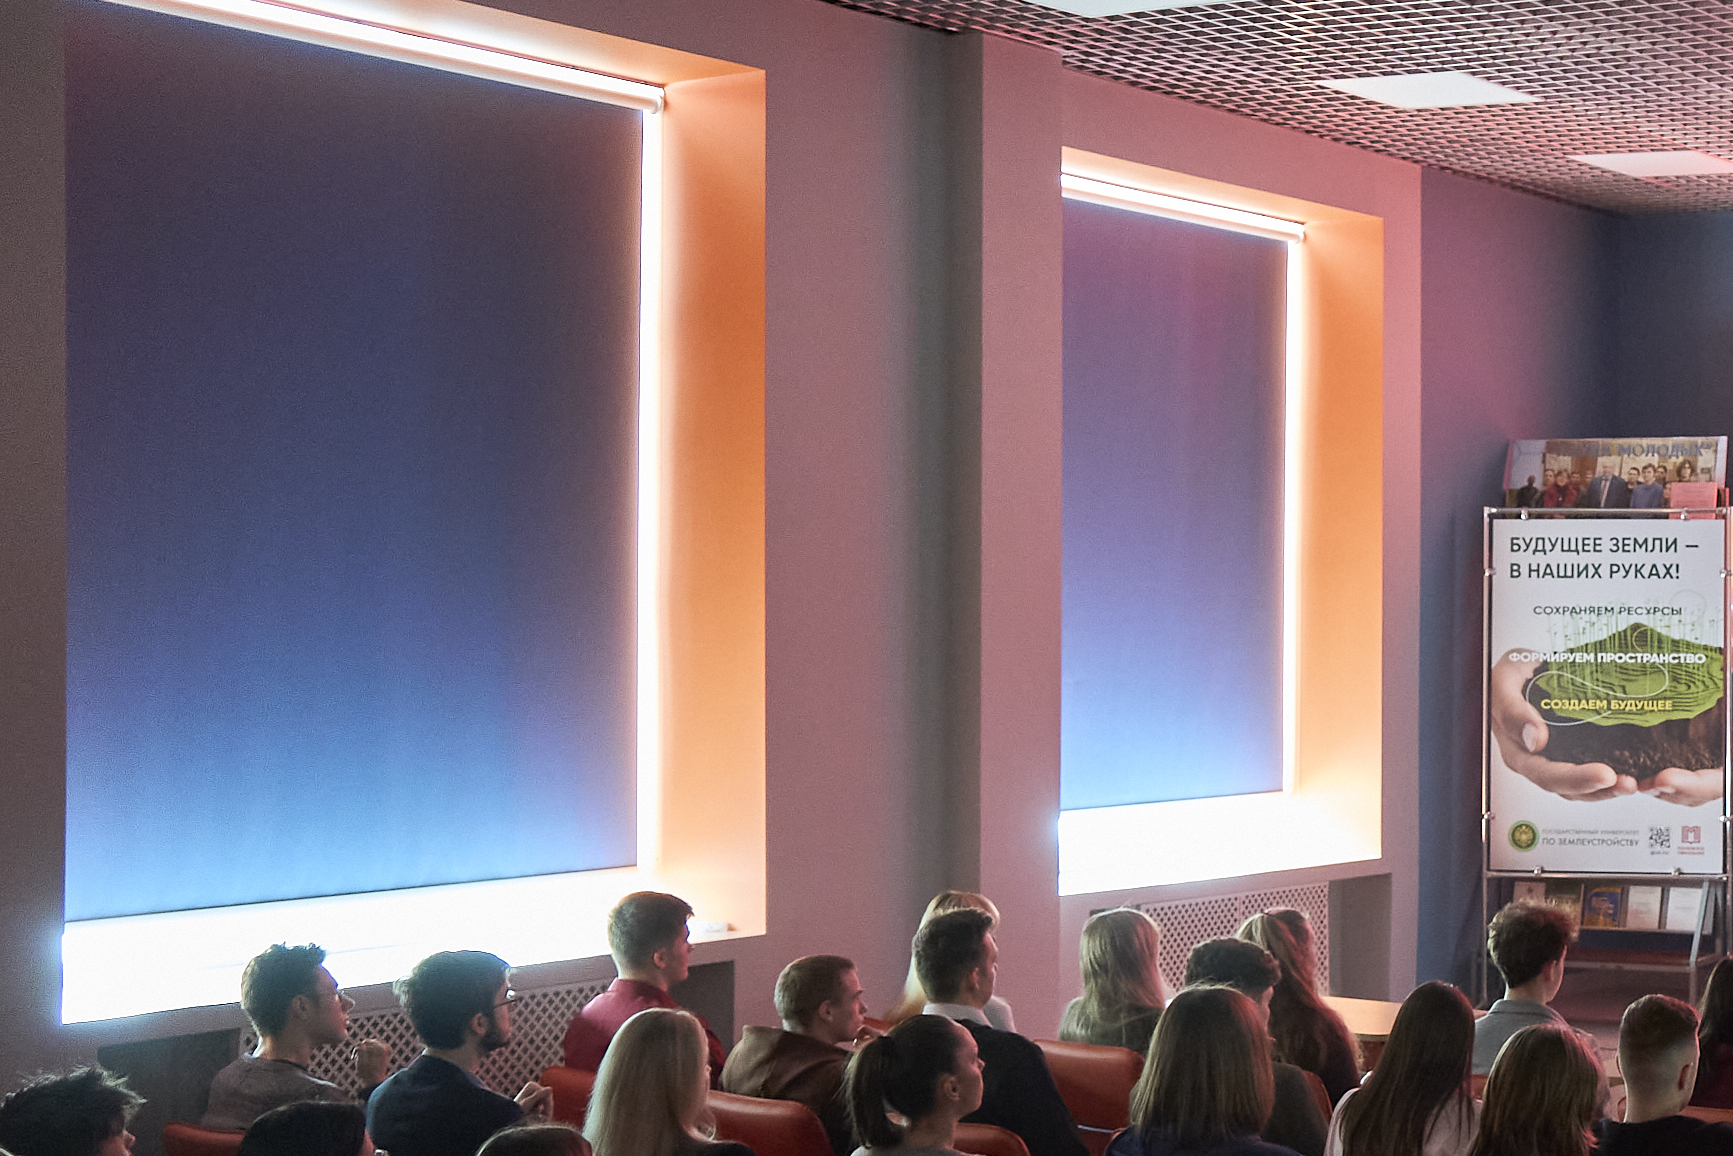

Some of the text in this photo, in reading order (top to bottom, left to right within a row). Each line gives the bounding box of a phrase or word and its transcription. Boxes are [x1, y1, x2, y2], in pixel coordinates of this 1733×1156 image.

[1510, 537, 1603, 555] БУДУЩЕЕ
[1609, 537, 1678, 553] ЗЕМЛИ
[1510, 563, 1680, 579] В НАШИХ РУКАХ!
[1533, 605, 1682, 616] СОХРАНЯЕМ РЕСУРСЫ
[1508, 651, 1706, 664] ФОРМИРУЕМ ПРОСТРАНСТВО
[1540, 700, 1673, 711] СОЗДАЕМ БУДУЩЕЕ
[1541, 836, 1640, 847] ПО ЗЕМЛЕУСТРОЙСТВУ
